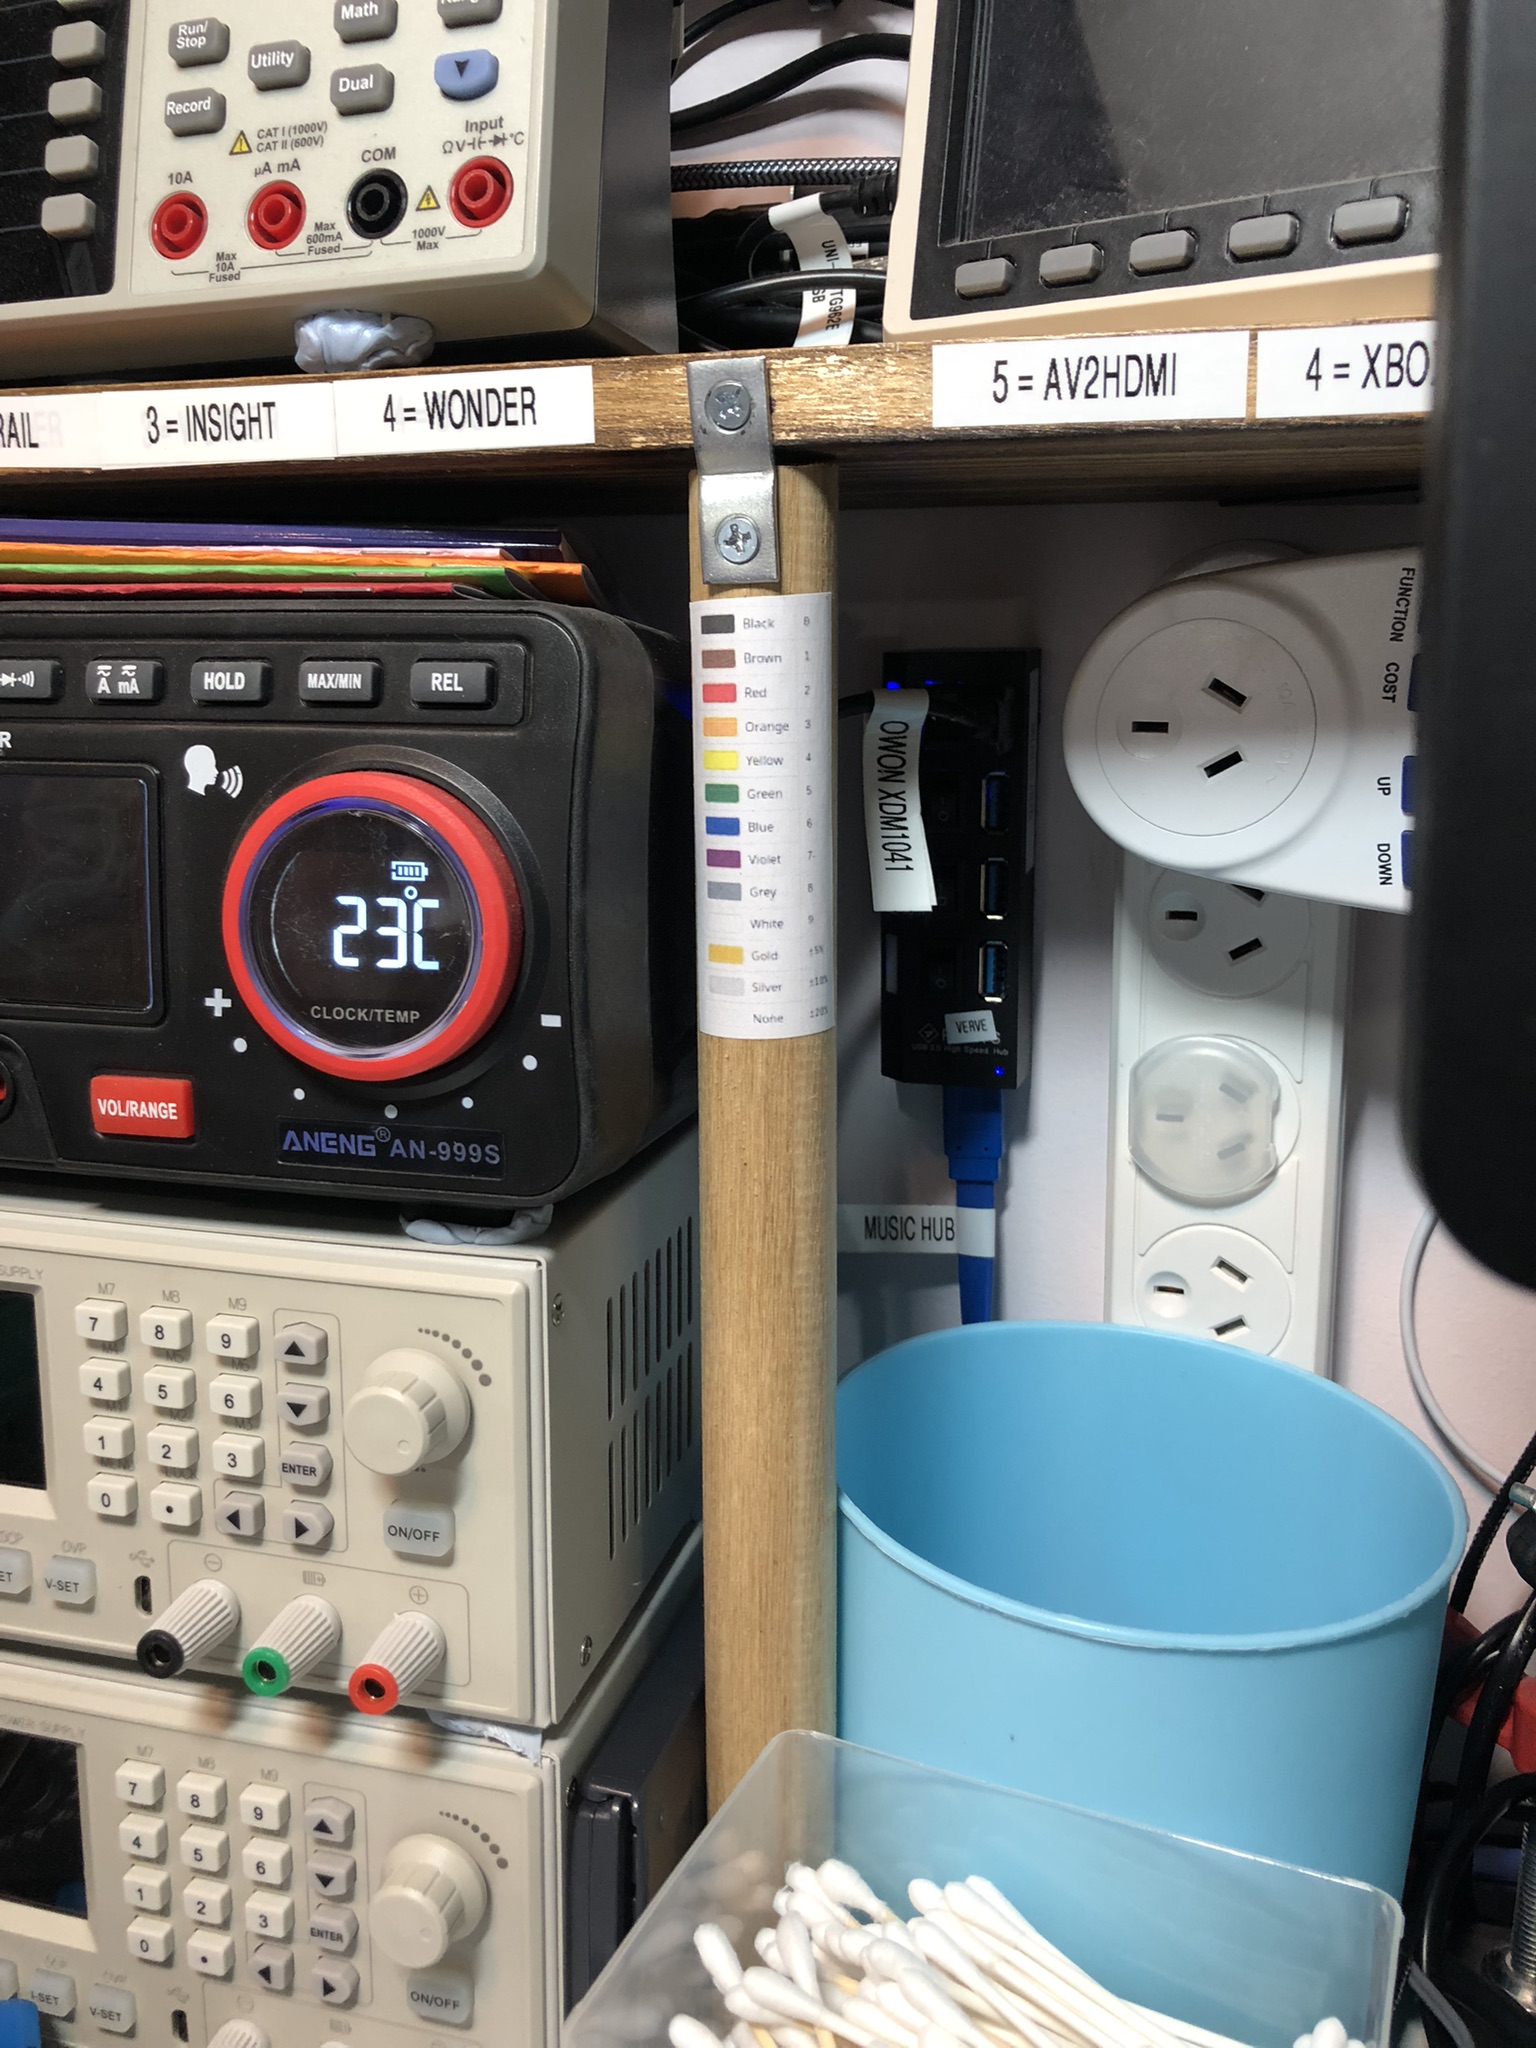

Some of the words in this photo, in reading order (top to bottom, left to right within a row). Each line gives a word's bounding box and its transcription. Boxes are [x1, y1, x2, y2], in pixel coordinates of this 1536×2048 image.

[341, 2, 379, 20] Math
[178, 21, 209, 36] Run/
[176, 36, 206, 49] Stop
[251, 51, 294, 69] Utility
[338, 74, 374, 92] Dual
[166, 97, 211, 115] Record
[257, 127, 279, 139] CAT
[288, 121, 328, 137] (1000V)
[465, 116, 504, 134] Input
[256, 141, 279, 153] CAT
[290, 136, 325, 151] (600V)
[361, 147, 396, 163] COM
[277, 158, 301, 173] mA
[168, 171, 193, 185] 10A
[314, 222, 336, 232] Max
[411, 226, 446, 240] 1000V
[306, 232, 343, 245] 600mA
[416, 240, 440, 251] Max
[216, 252, 237, 261] Max
[307, 244, 341, 256] Fused
[215, 261, 235, 272] 10A
[209, 271, 241, 283] Fused
[1306, 347, 1322, 392] 4
[1361, 339, 1434, 390] XBO
[993, 359, 1008, 403] 5
[1044, 352, 1177, 400] AV2HDMI
[383, 393, 396, 432] 4
[424, 385, 538, 430] WONDER
[146, 404, 160, 444] 3
[186, 401, 277, 442] INSIGHT
[1389, 567, 1415, 642] FUNCTION
[743, 617, 775, 630] Black
[744, 652, 782, 664] Brown
[804, 651, 810, 661] 1
[203, 672, 246, 691] HOLD
[307, 672, 362, 690] MAX/MIN
[430, 673, 464, 692] REL
[1381, 662, 1400, 704] COST
[744, 687, 767, 699] Red
[804, 685, 811, 696] 2
[745, 721, 790, 735] Orange
[804, 719, 811, 729] 3
[877, 720, 909, 784] OWON
[746, 755, 784, 767] Yellow
[805, 753, 812, 763] 4
[747, 789, 783, 800] Green
[806, 786, 813, 796] 5
[1377, 776, 1391, 796] UP
[748, 821, 774, 833] Blue
[806, 818, 813, 829] 6
[878, 789, 915, 872] XDM1041
[748, 854, 782, 865] Violet
[1377, 843, 1393, 886] DOWN
[750, 886, 777, 900] Grey
[807, 883, 814, 893] 8
[750, 918, 784, 930] White
[808, 915, 814, 925] 9
[751, 950, 778, 961] Gold
[752, 982, 782, 993] Silver
[310, 1005, 420, 1024] CLOCK/TEMP
[753, 1013, 784, 1024] None
[955, 1019, 988, 1034] VERVE
[97, 1098, 178, 1120] VOL/RANGE
[390, 1138, 500, 1165] AN-999S
[864, 1215, 916, 1241] MUSIC
[921, 1217, 955, 1241] HUB
[98, 1282, 116, 1296] M7
[162, 1289, 181, 1303] M8
[228, 1297, 247, 1311] M9
[89, 1317, 98, 1331] 7
[155, 1325, 164, 1340] 8
[221, 1333, 231, 1348] 9
[93, 1377, 103, 1391] 4
[158, 1384, 168, 1399] 5
[224, 1393, 235, 1409] 6
[98, 1435, 105, 1450] 1
[162, 1444, 171, 1459] 2
[227, 1452, 237, 1468] 3
[281, 1462, 317, 1477] ENTER
[101, 1493, 110, 1508] 0
[387, 1525, 440, 1543] ON/OFF
[44, 1577, 80, 1593] V-SET
[128, 1782, 137, 1795] 7
[190, 1794, 200, 1808] 8
[253, 1807, 263, 1820] 9
[132, 1836, 141, 1848] 4
[194, 1848, 202, 1862] 5
[256, 1860, 265, 1875] 6
[137, 1888, 143, 1901] 1
[197, 1901, 206, 1915] 2
[259, 1914, 268, 1928] 3
[310, 1927, 343, 1942] ENTER
[140, 1939, 149, 1953] 0
[410, 1990, 460, 2011] ON/OFF
[89, 2006, 122, 2022] V-SET
